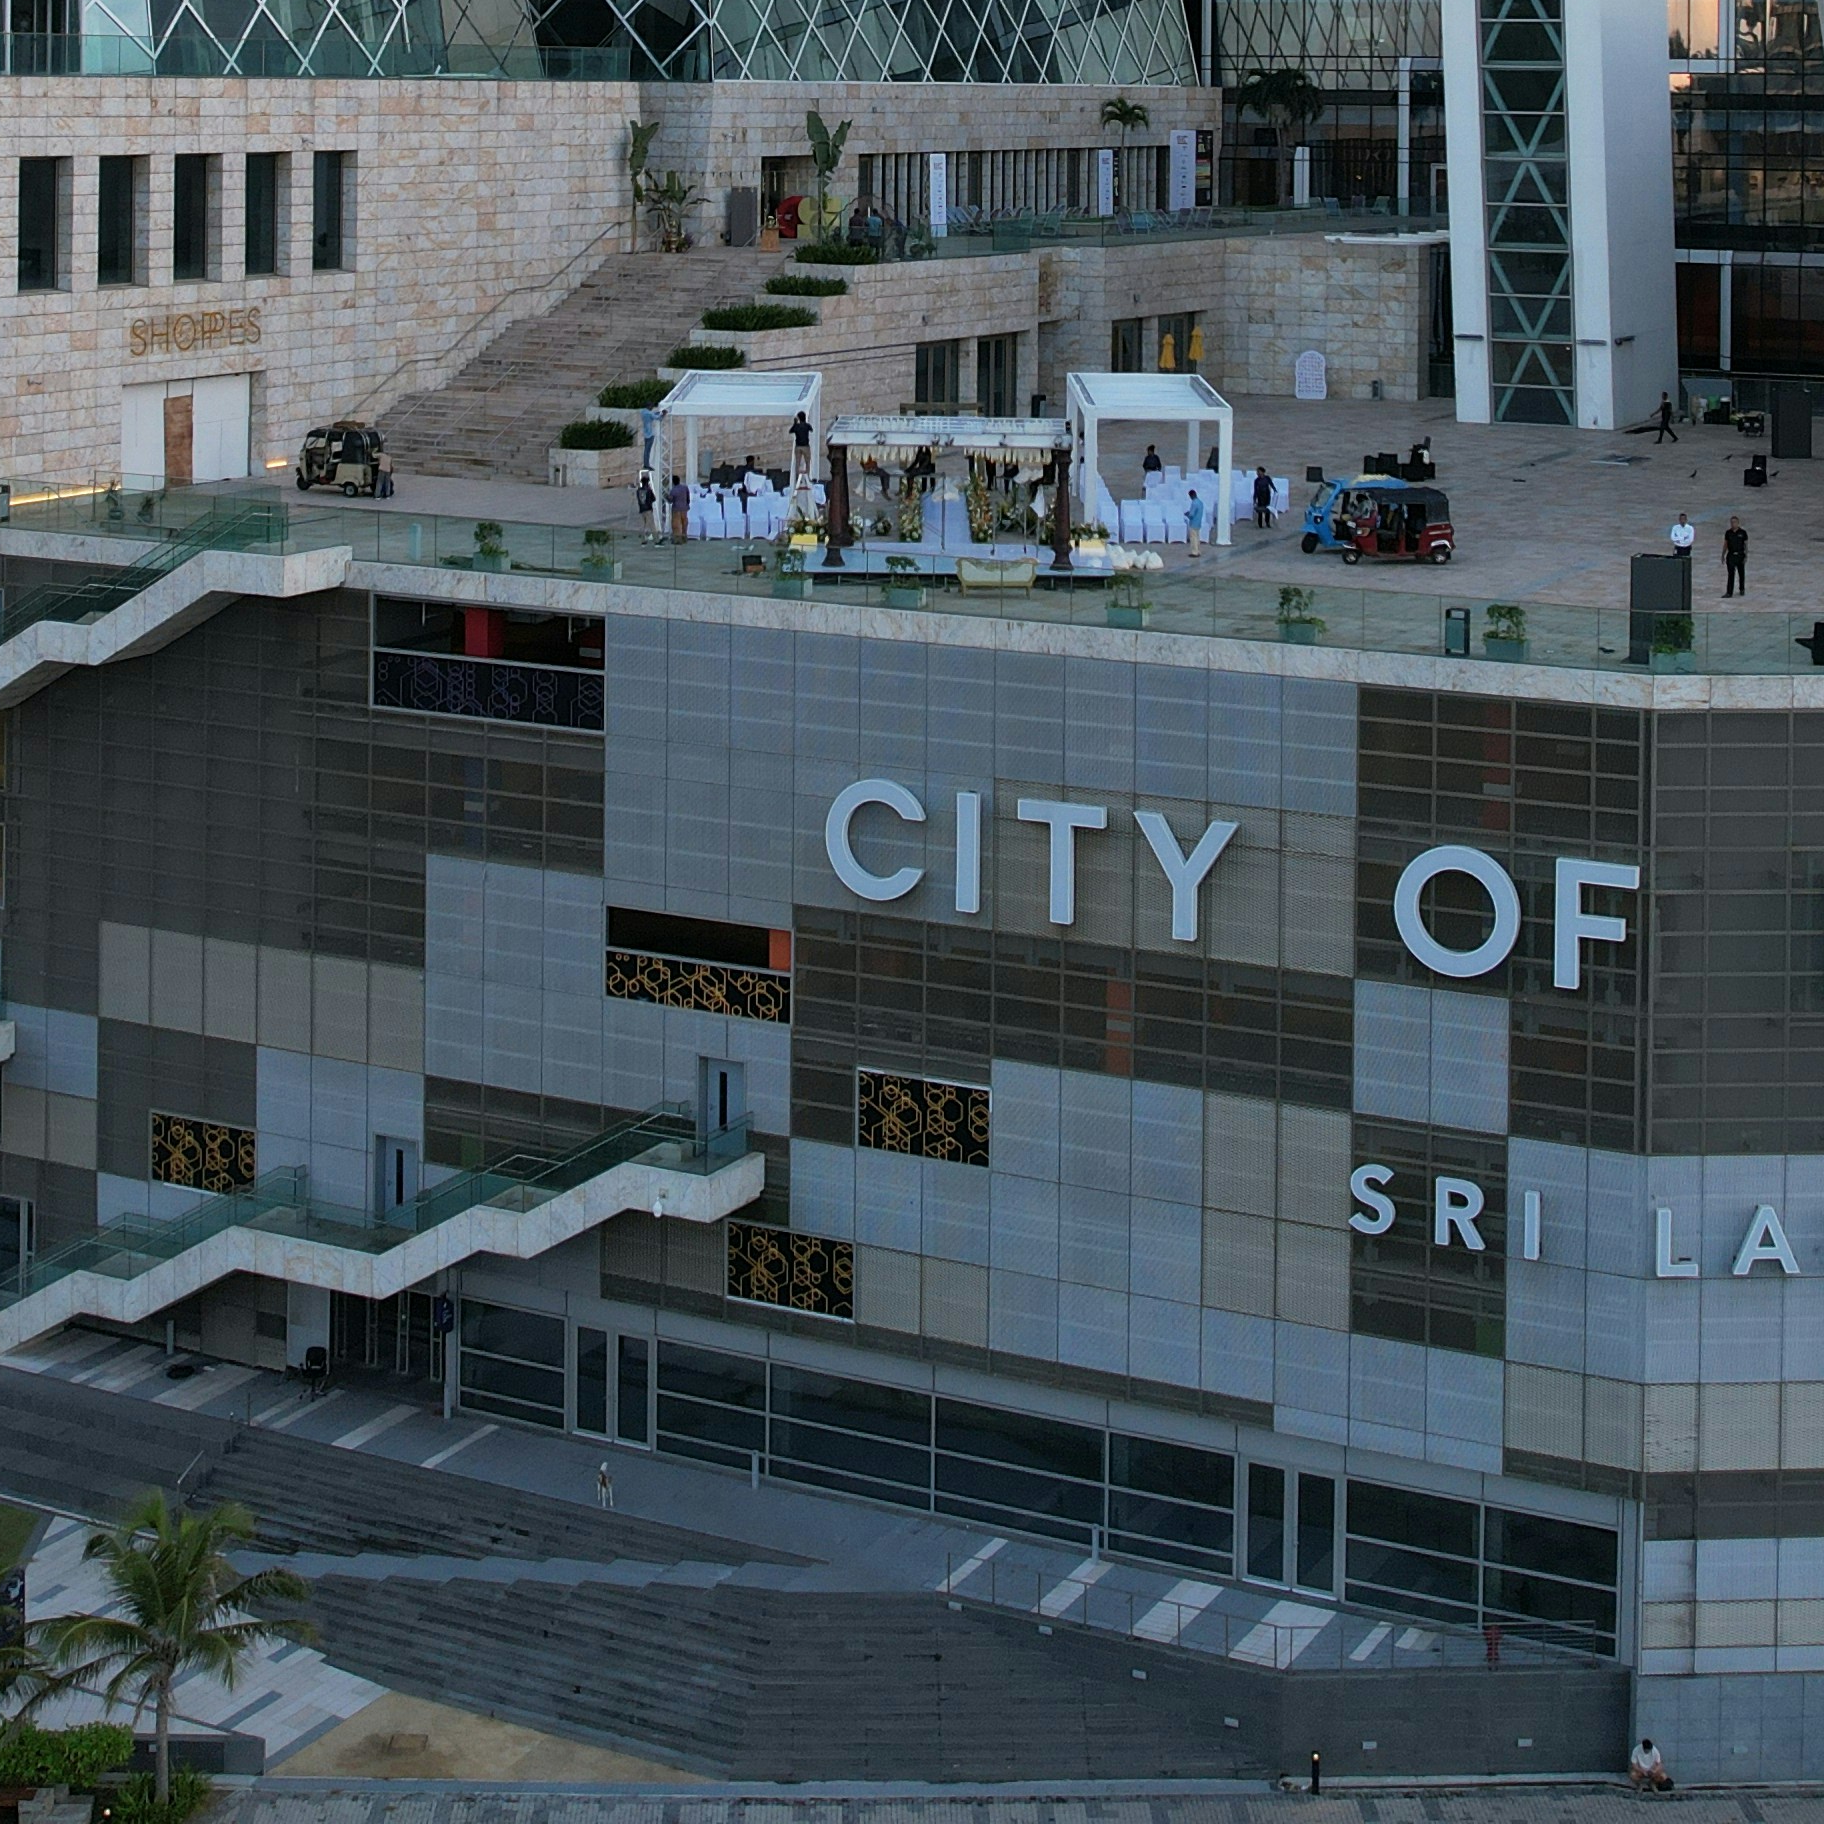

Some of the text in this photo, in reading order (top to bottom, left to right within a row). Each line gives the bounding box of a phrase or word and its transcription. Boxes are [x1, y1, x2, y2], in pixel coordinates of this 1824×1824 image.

[130, 307, 261, 357] SHOPPES
[825, 778, 1240, 942] CITY
[1393, 844, 1641, 991] OF
[1348, 1163, 1541, 1261] SRI
